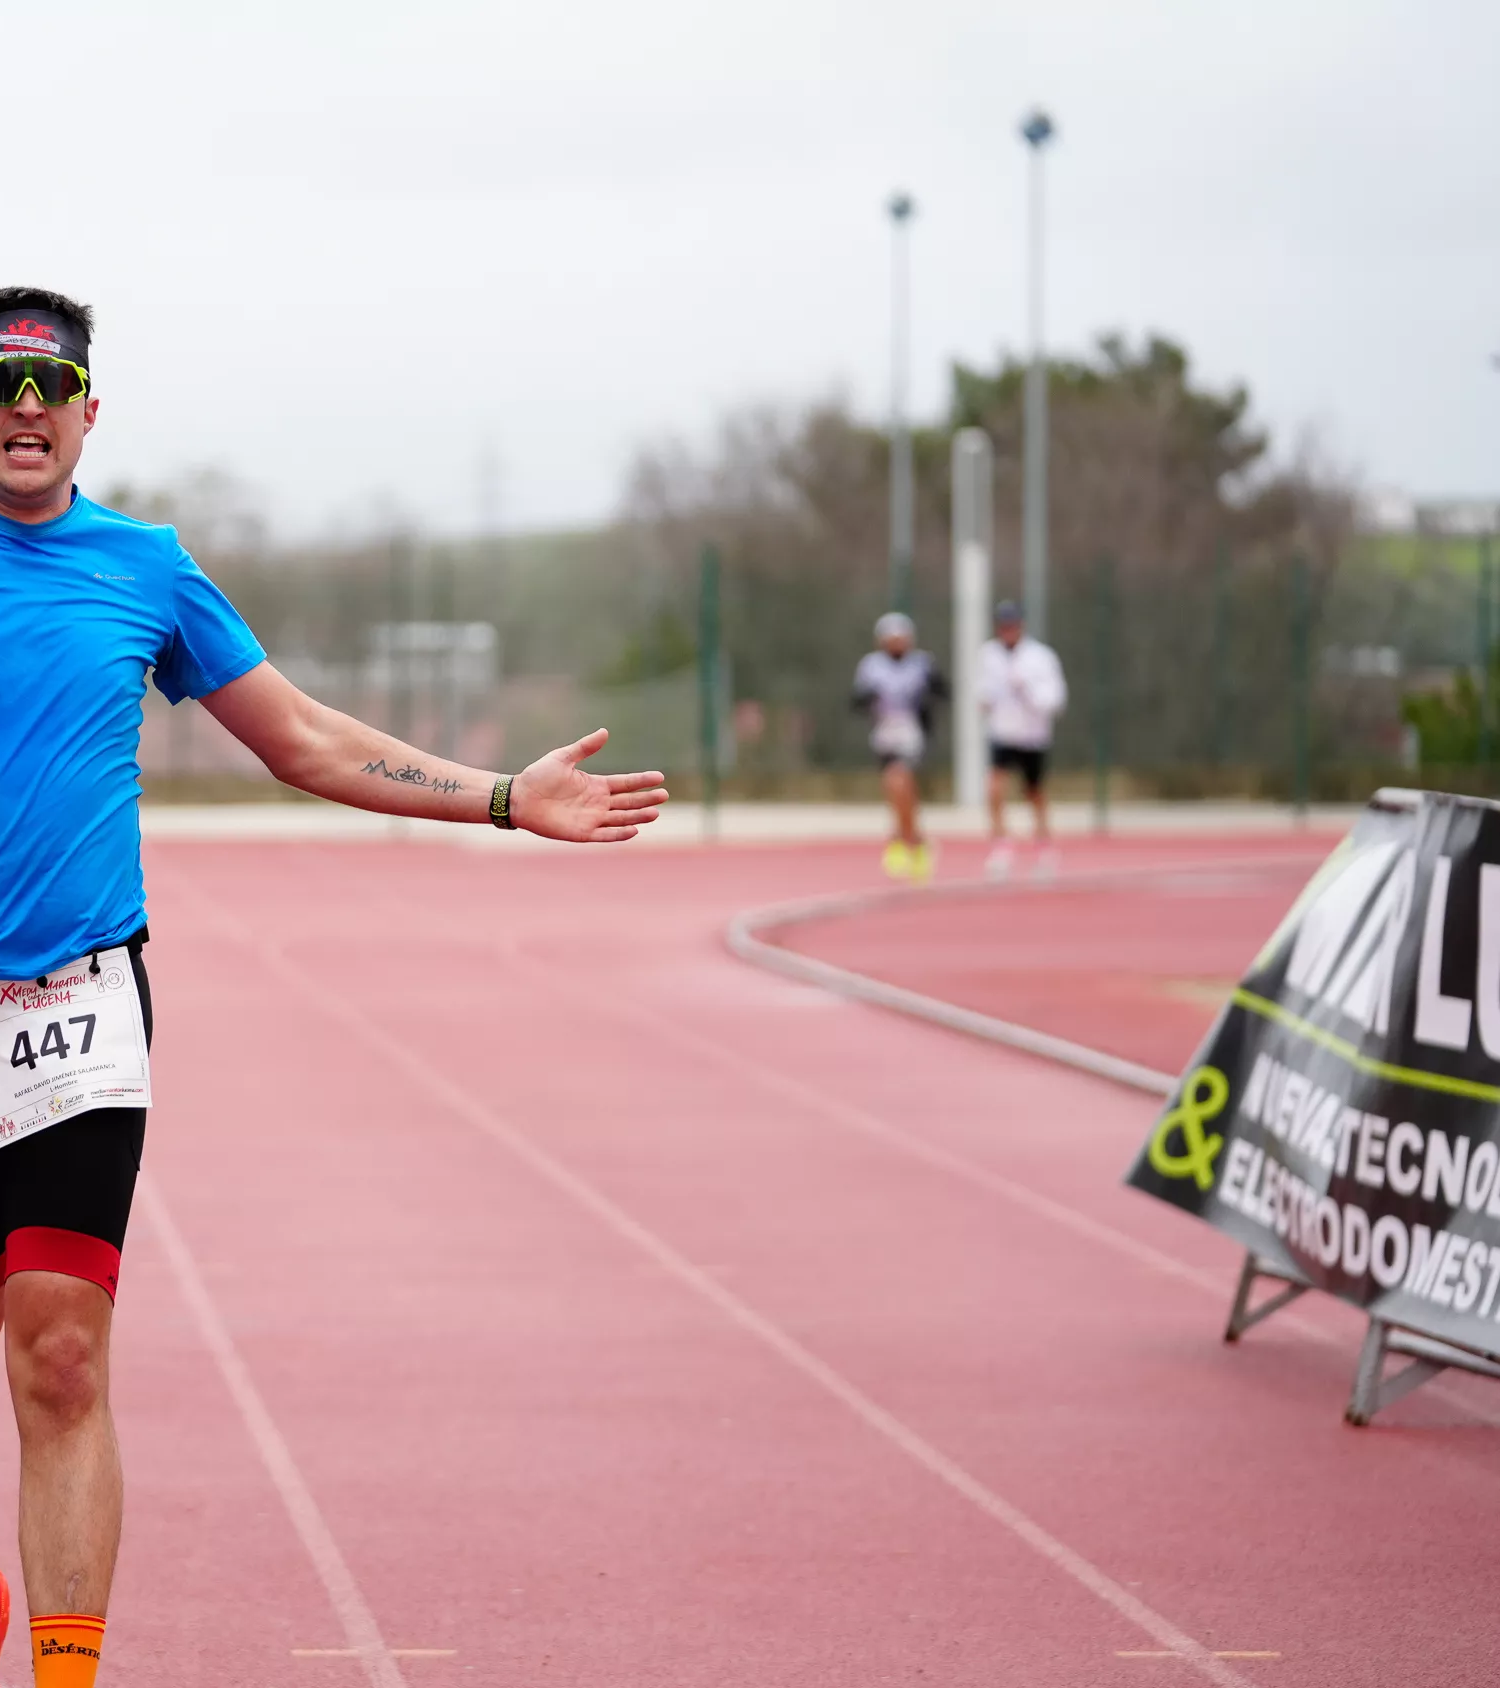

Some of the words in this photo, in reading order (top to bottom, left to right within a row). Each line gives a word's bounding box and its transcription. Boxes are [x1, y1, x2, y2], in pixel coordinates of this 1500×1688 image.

[23, 990, 78, 1011] LUCENA
[10, 1013, 96, 1070] 447
[13, 1086, 33, 1099] RAFAEL
[33, 1078, 51, 1091] DAVID
[77, 1063, 116, 1075] SALAMANCA
[49, 1080, 78, 1093] L-Hombre
[1148, 1065, 1230, 1190] &
[1217, 1137, 1500, 1324] ELECTRODOMEST
[40, 1638, 58, 1648] LA
